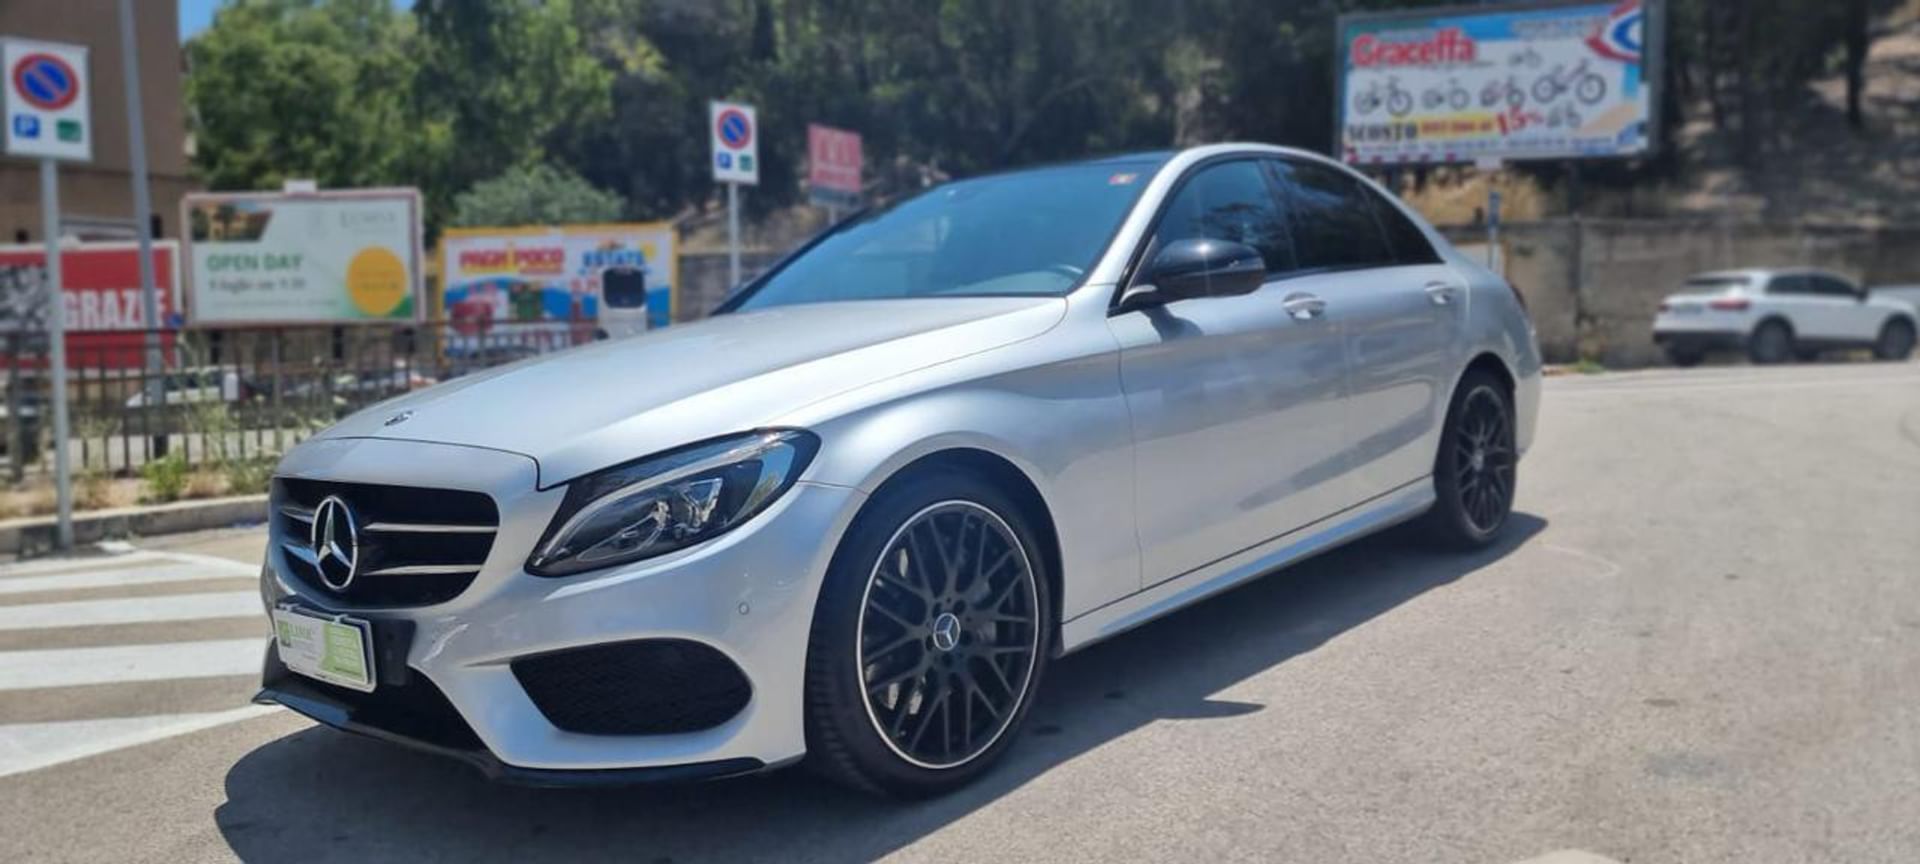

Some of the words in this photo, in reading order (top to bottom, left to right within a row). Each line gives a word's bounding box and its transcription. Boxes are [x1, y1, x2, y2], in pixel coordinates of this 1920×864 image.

[1352, 27, 1476, 66] Graceffa
[207, 253, 259, 271] OPEN
[264, 253, 304, 271] DAY
[61, 288, 165, 331] GRAZE
